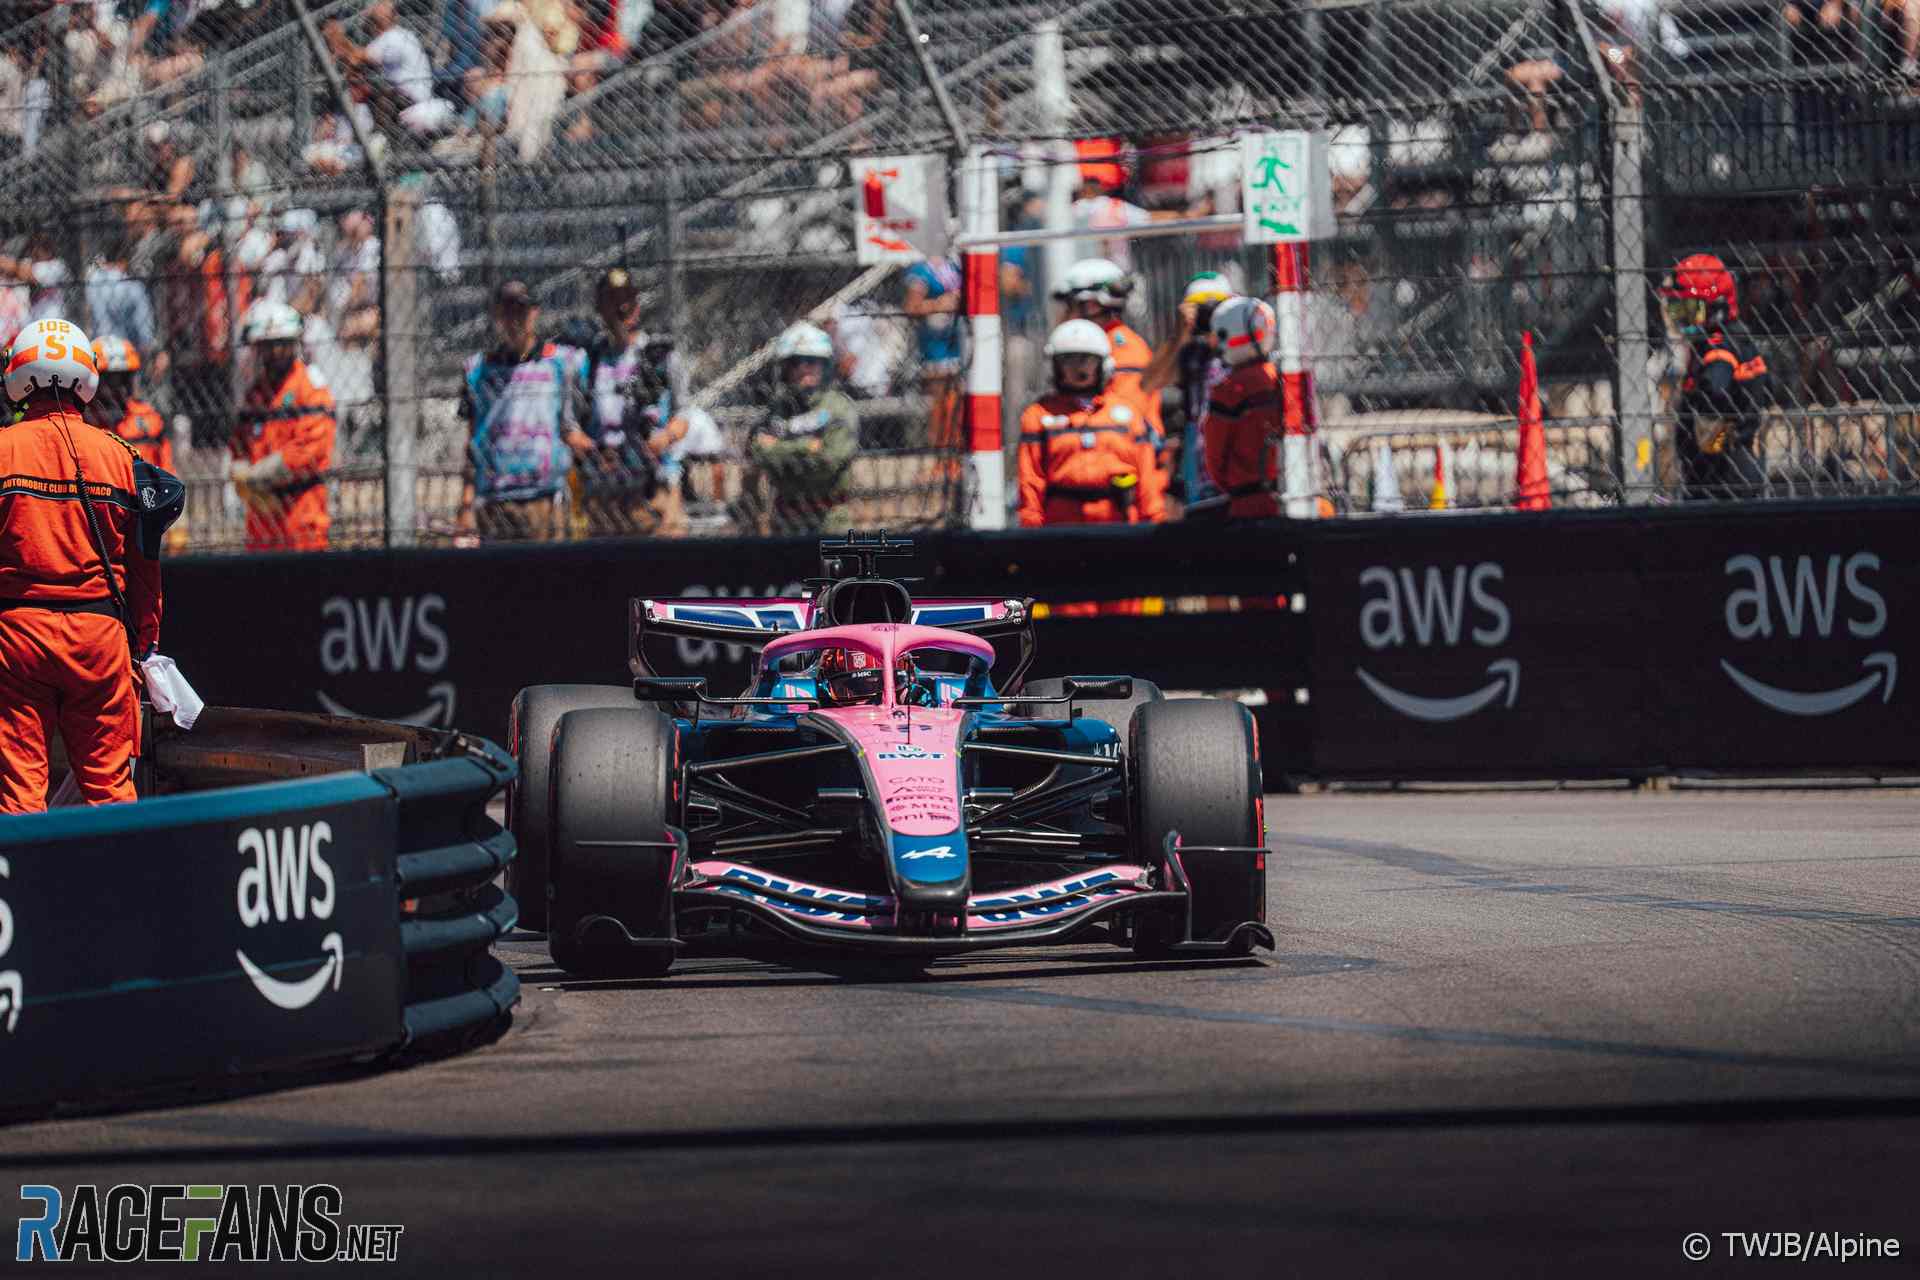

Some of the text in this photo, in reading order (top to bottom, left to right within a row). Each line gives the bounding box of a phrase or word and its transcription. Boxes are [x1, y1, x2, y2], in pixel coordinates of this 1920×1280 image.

[37, 320, 70, 333] 102
[44, 335, 67, 360] S
[3, 478, 48, 492] AUTOMOBILE
[49, 483, 67, 494] CLUB
[1359, 562, 1511, 648] aws
[1723, 552, 1888, 639] aws
[320, 595, 448, 672] aws
[877, 752, 945, 761] BWT
[237, 821, 336, 927] aws
